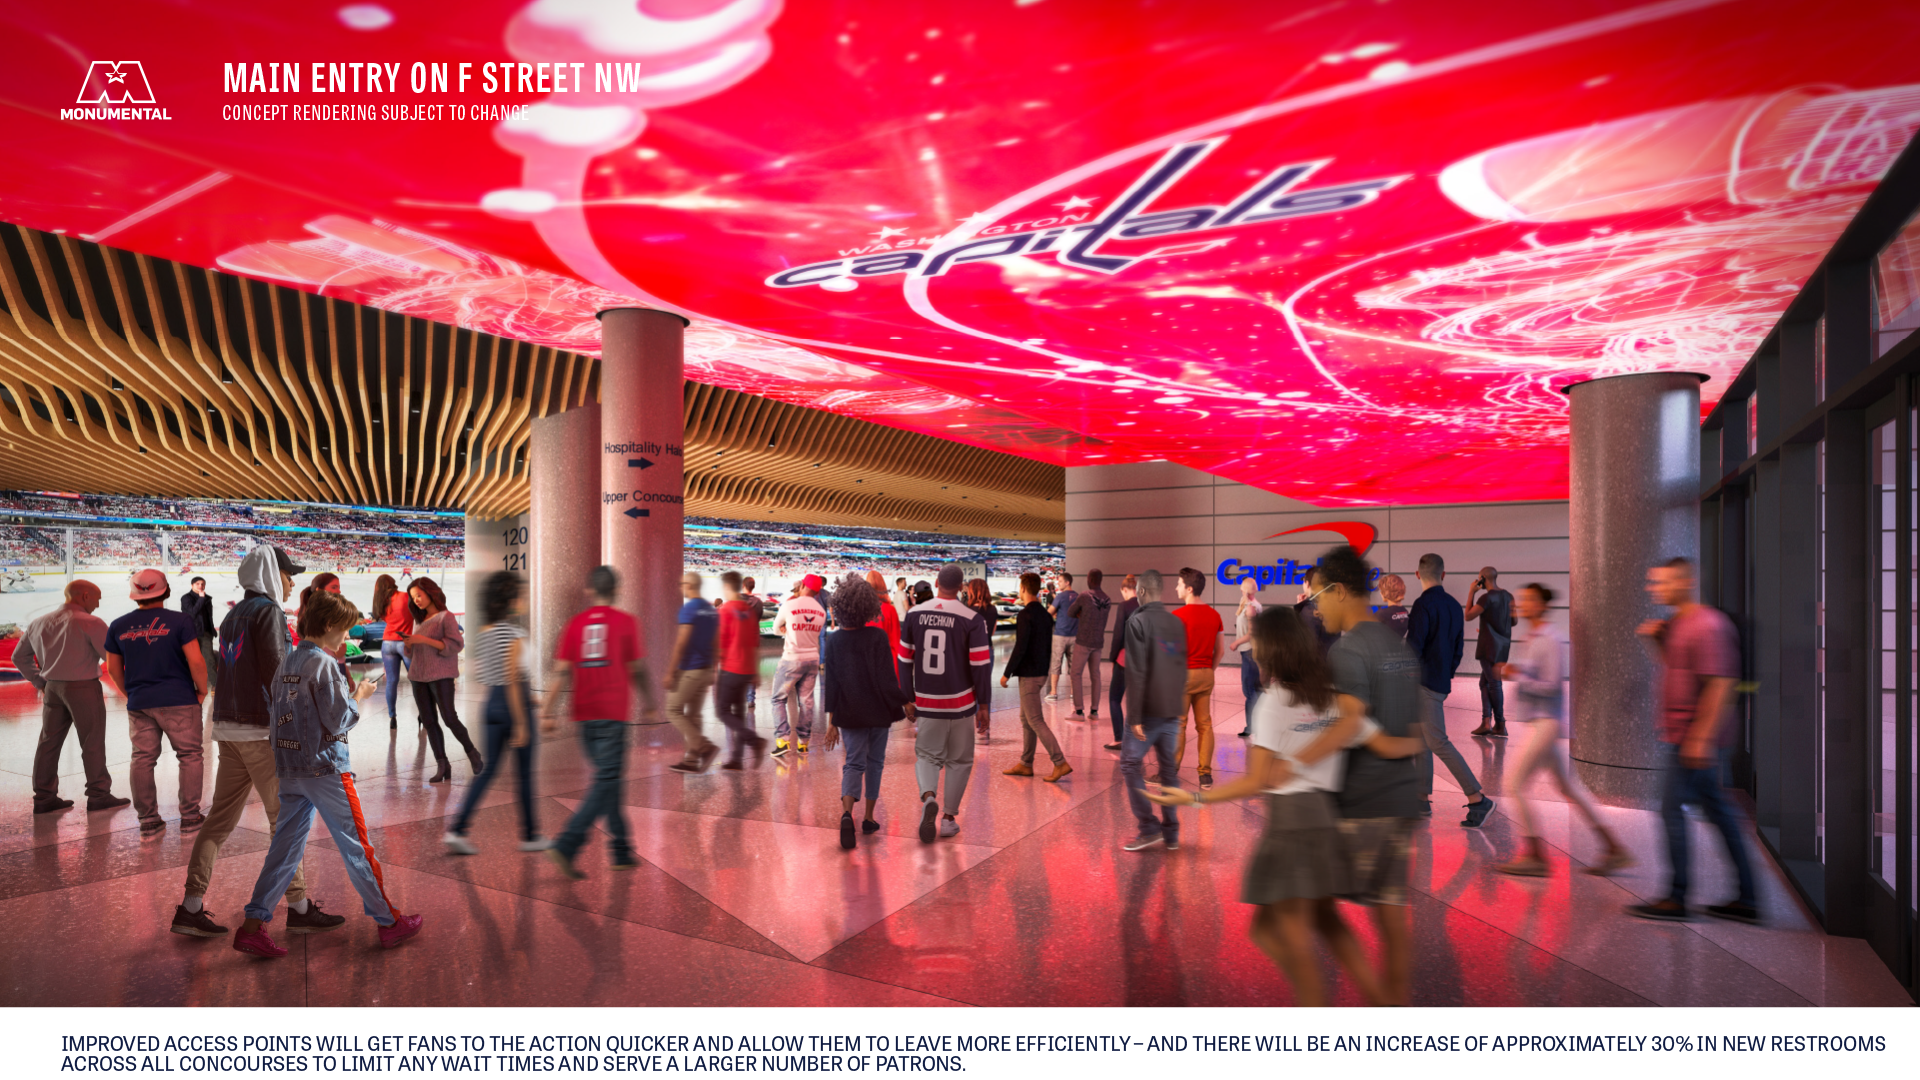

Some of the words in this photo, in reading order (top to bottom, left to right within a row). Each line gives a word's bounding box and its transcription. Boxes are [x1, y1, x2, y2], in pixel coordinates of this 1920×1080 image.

[838, 211, 1091, 257] WASHGTON
[604, 441, 662, 457] Hospitality
[502, 526, 529, 547] 120
[502, 552, 527, 572] 121
[962, 567, 980, 577] 121
[918, 613, 956, 629] OVECHKIN
[922, 628, 947, 676] 8
